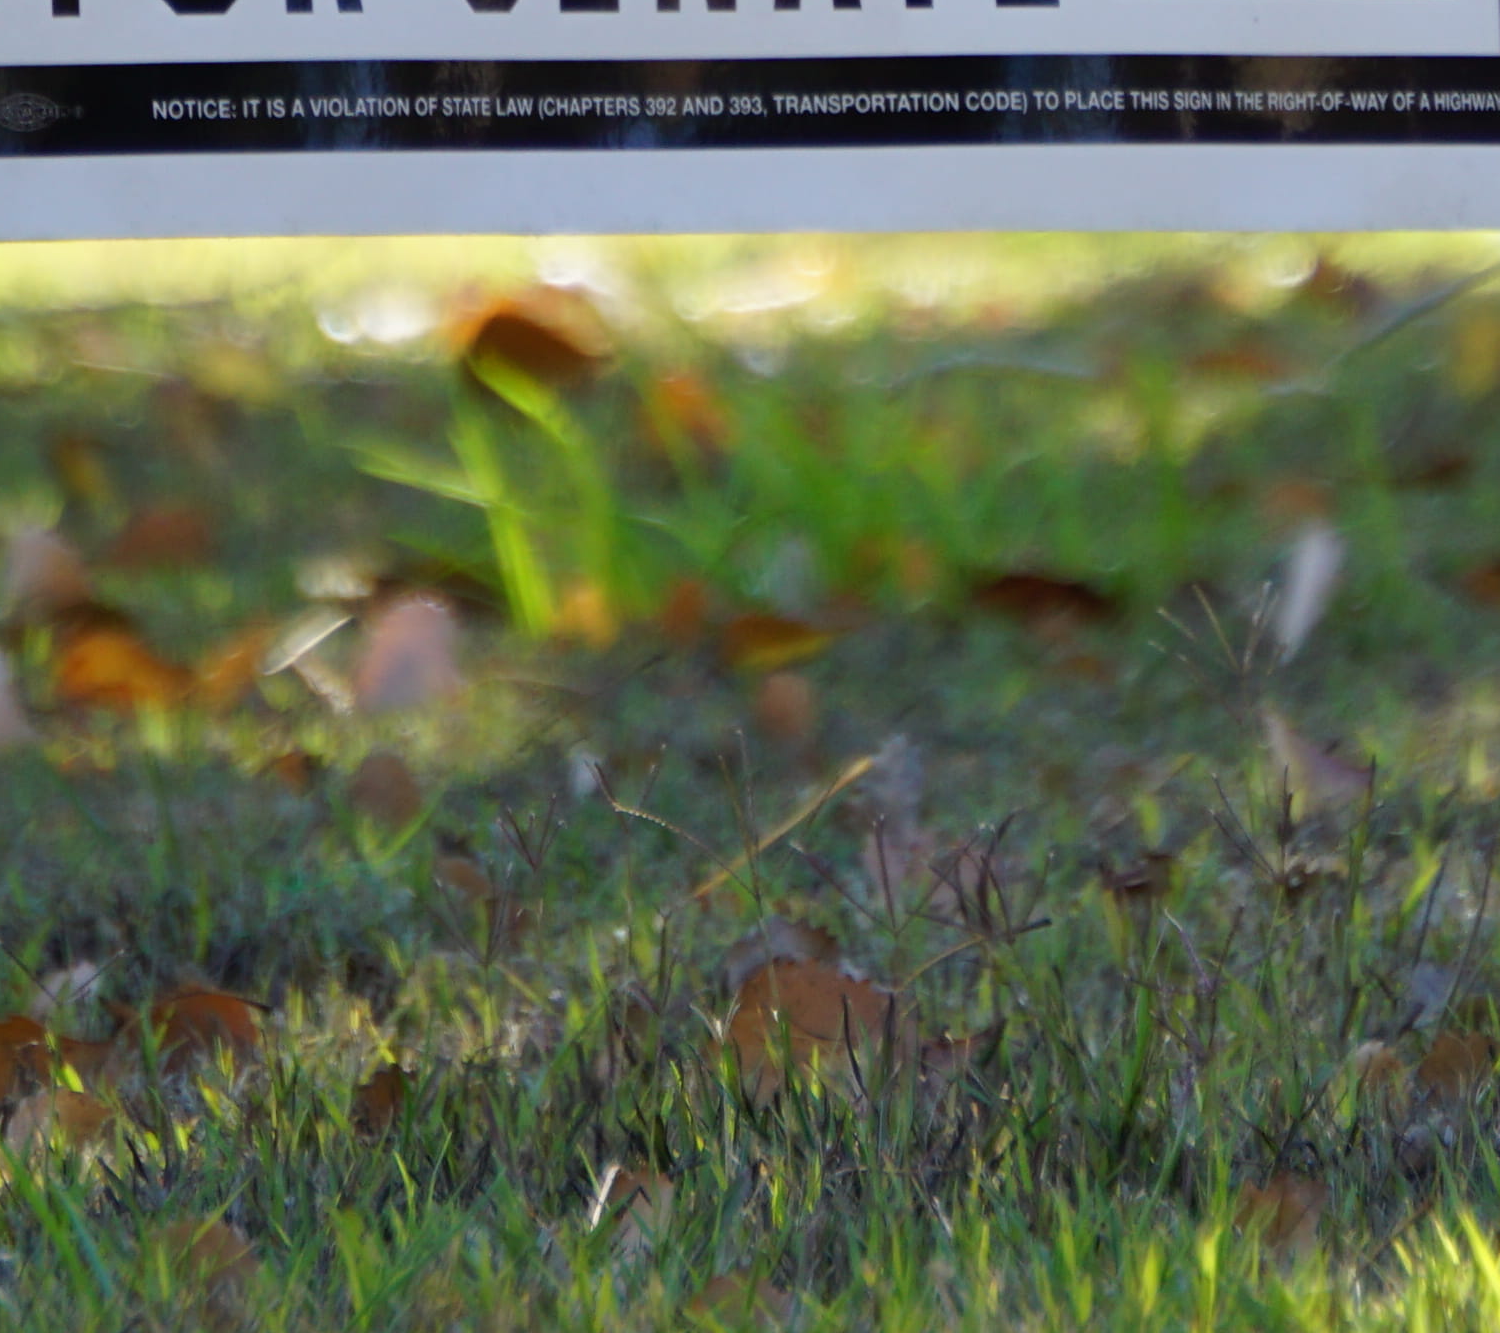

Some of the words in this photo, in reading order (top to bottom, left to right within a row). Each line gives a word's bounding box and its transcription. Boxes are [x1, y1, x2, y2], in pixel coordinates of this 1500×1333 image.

[151, 99, 237, 120] NOTICE:
[242, 99, 261, 118] IT
[266, 98, 286, 118] IS
[292, 98, 305, 117] A
[309, 96, 410, 117] VIOLATION
[414, 96, 437, 117] OF
[442, 96, 491, 117] STATE
[495, 96, 534, 116] LAW
[538, 95, 641, 120] (CHAPTERS
[645, 95, 677, 116] 392
[682, 95, 724, 115] AND
[729, 95, 769, 117] 393,
[772, 92, 961, 114] TRANSPORTATION
[965, 91, 1028, 114] CODE)
[1032, 90, 1060, 111] TO
[1063, 90, 1125, 111] PLACE
[1129, 90, 1170, 111] THIS
[1173, 90, 1213, 111] SIGN
[1216, 90, 1232, 110] IN
[1235, 91, 1264, 111] THE
[1267, 90, 1388, 112] RIGHT-OF-WAY
[1392, 91, 1415, 111] OF
[1419, 91, 1431, 110] A
